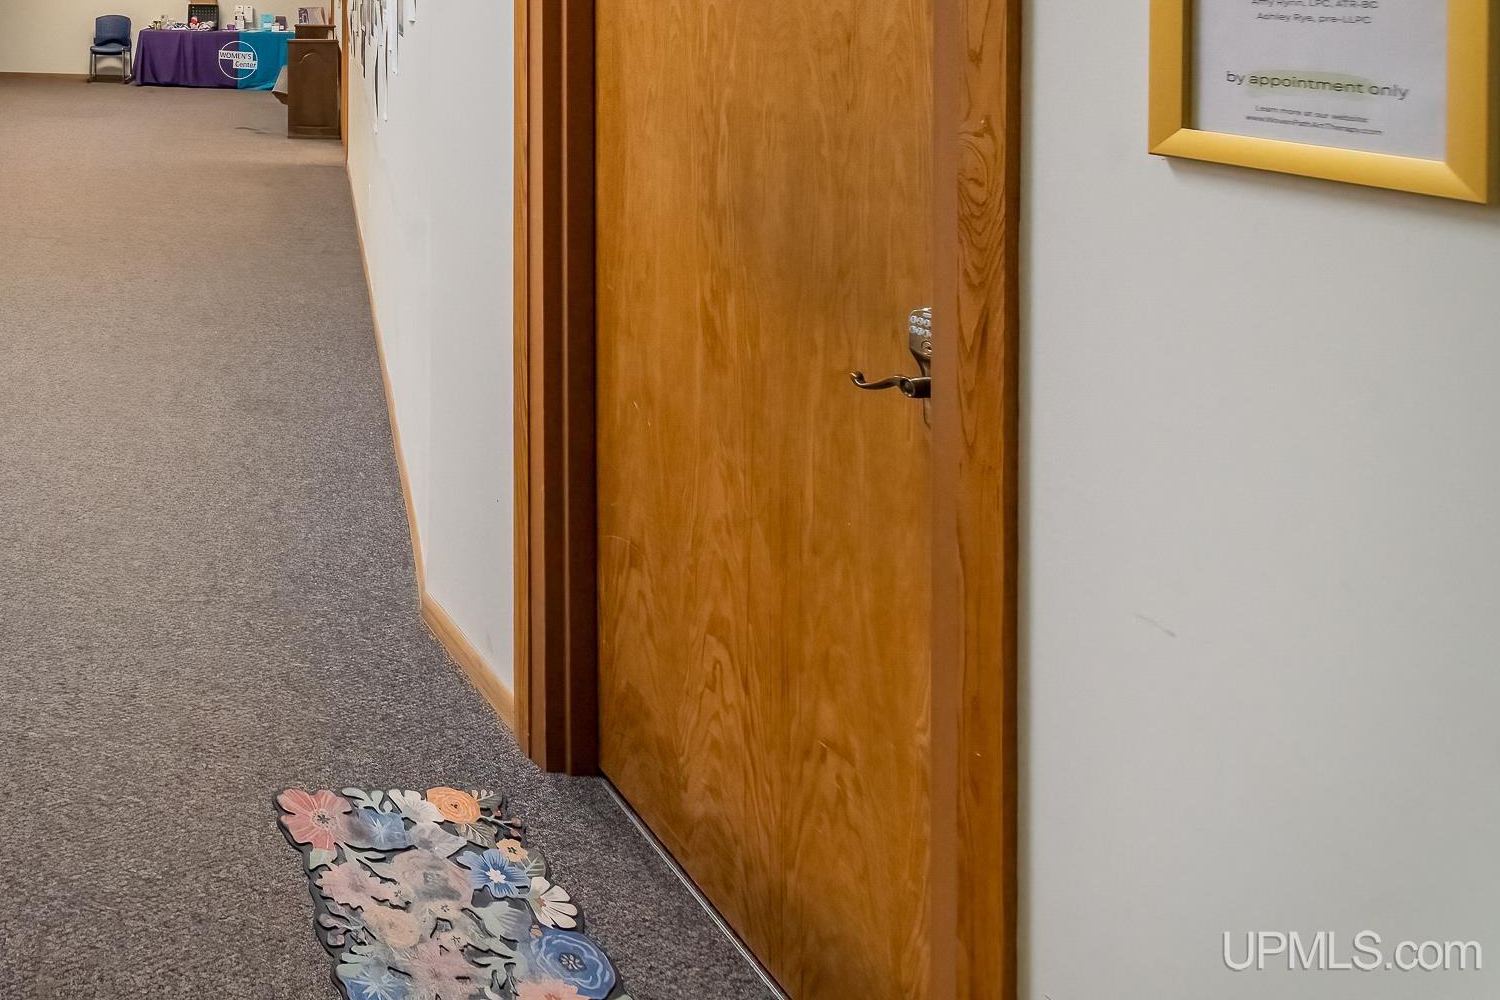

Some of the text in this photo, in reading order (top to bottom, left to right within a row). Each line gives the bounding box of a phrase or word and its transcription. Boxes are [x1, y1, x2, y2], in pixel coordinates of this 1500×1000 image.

[219, 51, 252, 60] WOMEN'S
[234, 60, 257, 68] Center
[1226, 71, 1410, 101] by appointment only
